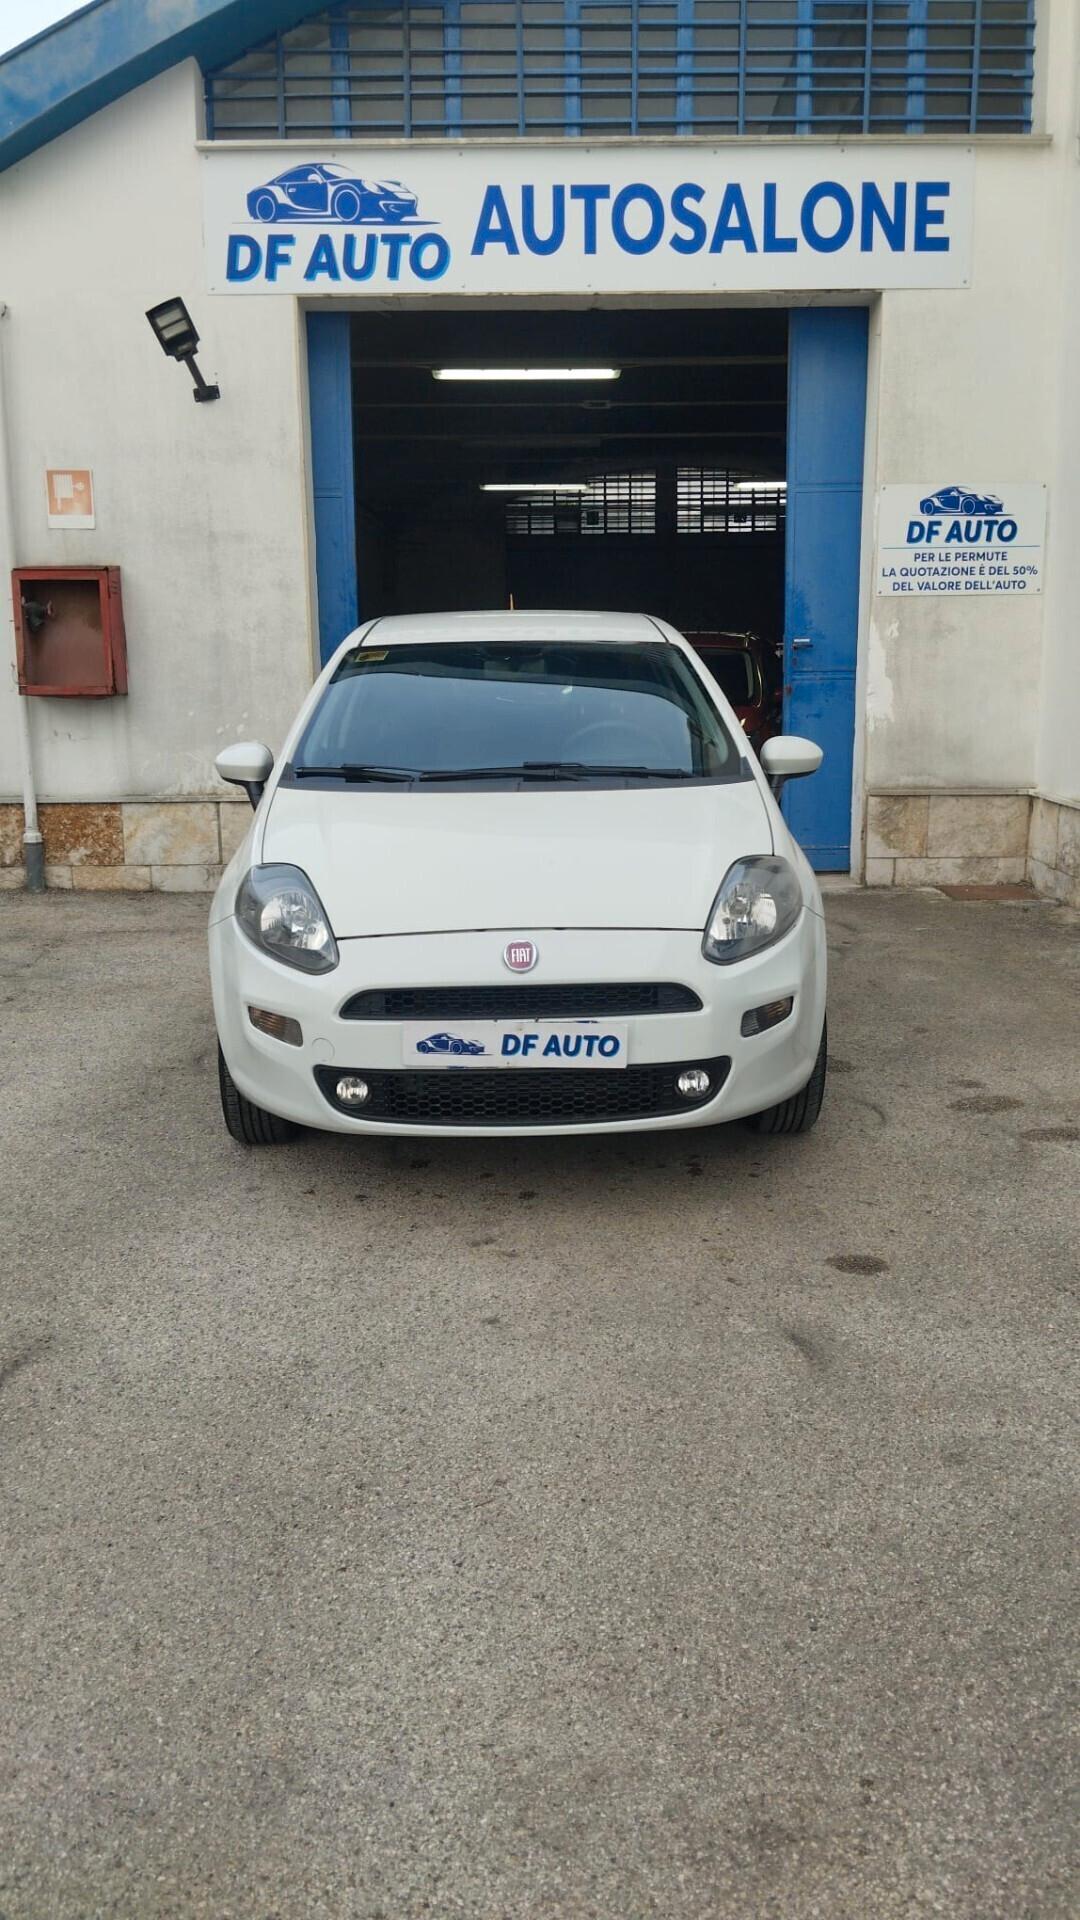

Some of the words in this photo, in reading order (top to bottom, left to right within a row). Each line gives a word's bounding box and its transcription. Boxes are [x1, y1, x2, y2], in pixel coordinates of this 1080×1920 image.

[470, 181, 950, 256] AUTOSALONE
[226, 232, 296, 281] DF
[304, 232, 451, 281] AUTO
[906, 520, 942, 544] DF
[945, 519, 1018, 543] AUTO
[914, 552, 935, 562] PER
[938, 552, 951, 562] LE
[954, 551, 1008, 562] PERMUTE
[882, 567, 897, 577] LA
[900, 566, 975, 577] QUOTAZIONE
[988, 566, 1010, 576] DEL
[1012, 565, 1038, 575] 50%
[892, 581, 914, 592] DEL
[917, 580, 961, 591] VALORE
[964, 580, 1026, 591] DELL'AUTO
[511, 948, 531, 963] FIAT
[501, 1033, 540, 1057] DF
[542, 1034, 621, 1057] AUTO
